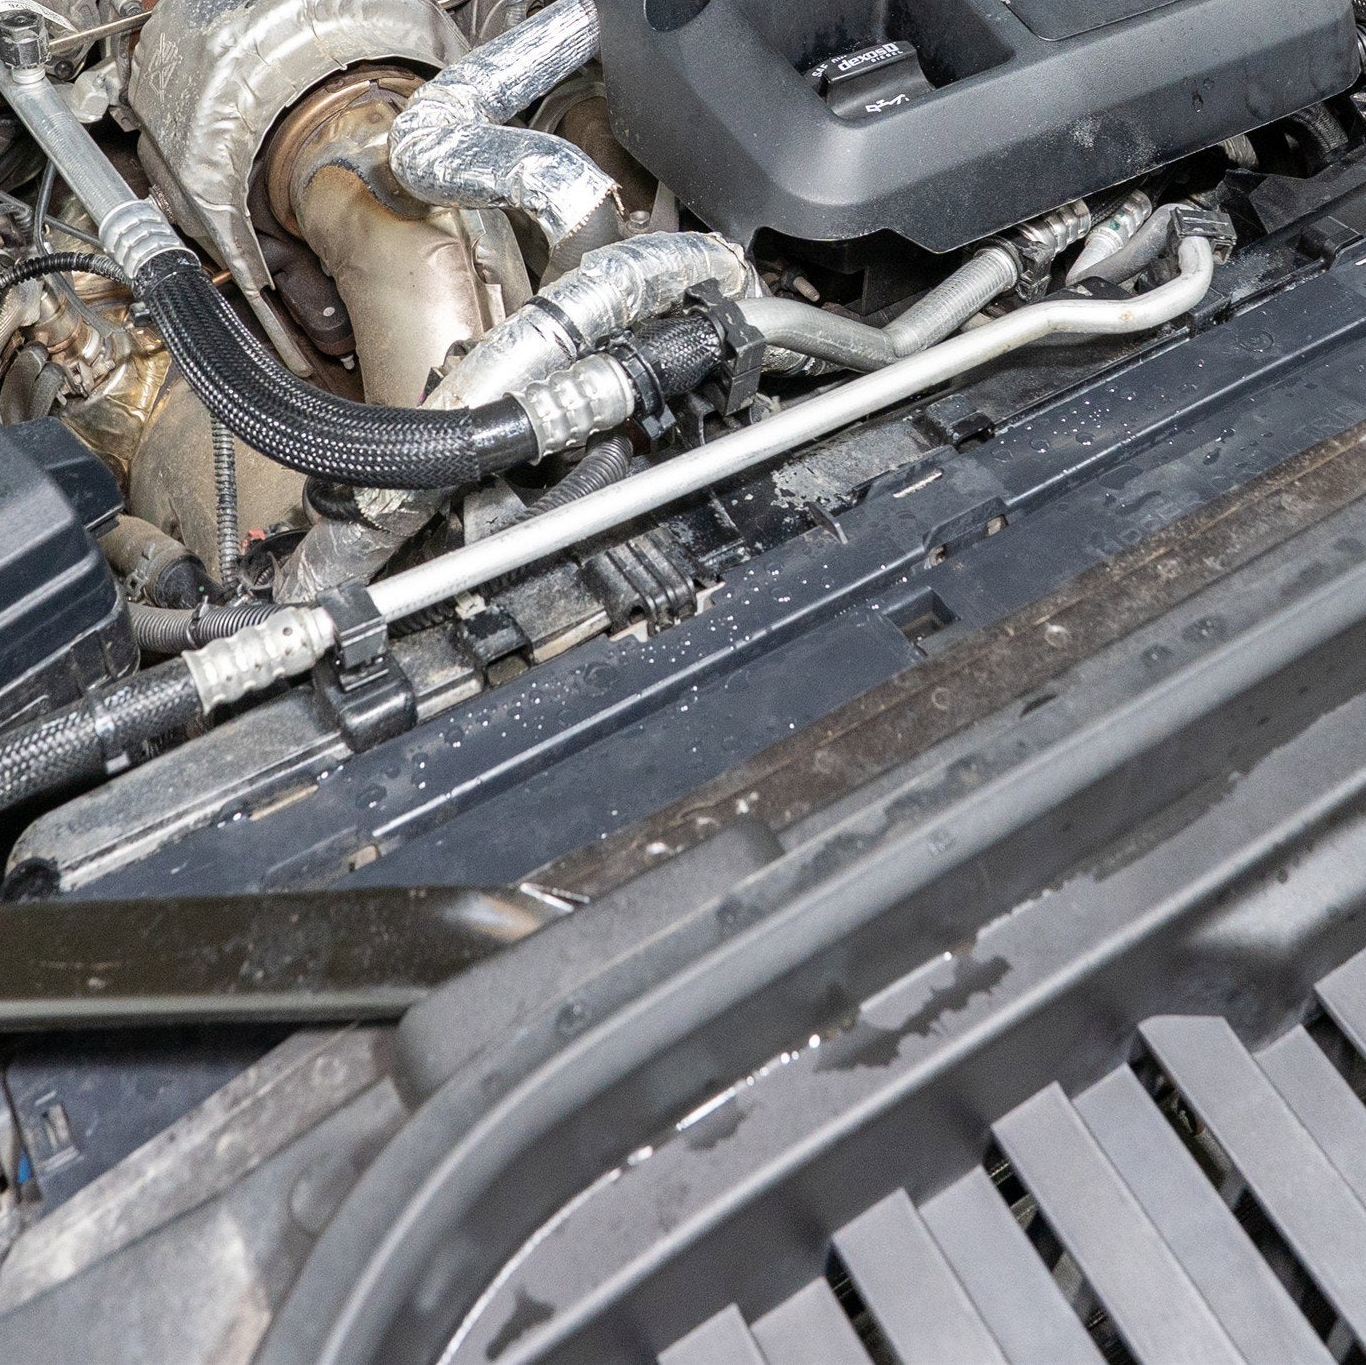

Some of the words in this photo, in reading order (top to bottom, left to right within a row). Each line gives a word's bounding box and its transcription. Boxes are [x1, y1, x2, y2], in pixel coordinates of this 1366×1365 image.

[838, 42, 900, 72] dexosD
[870, 50, 904, 63] DIESEL
[812, 64, 829, 78] SAE
